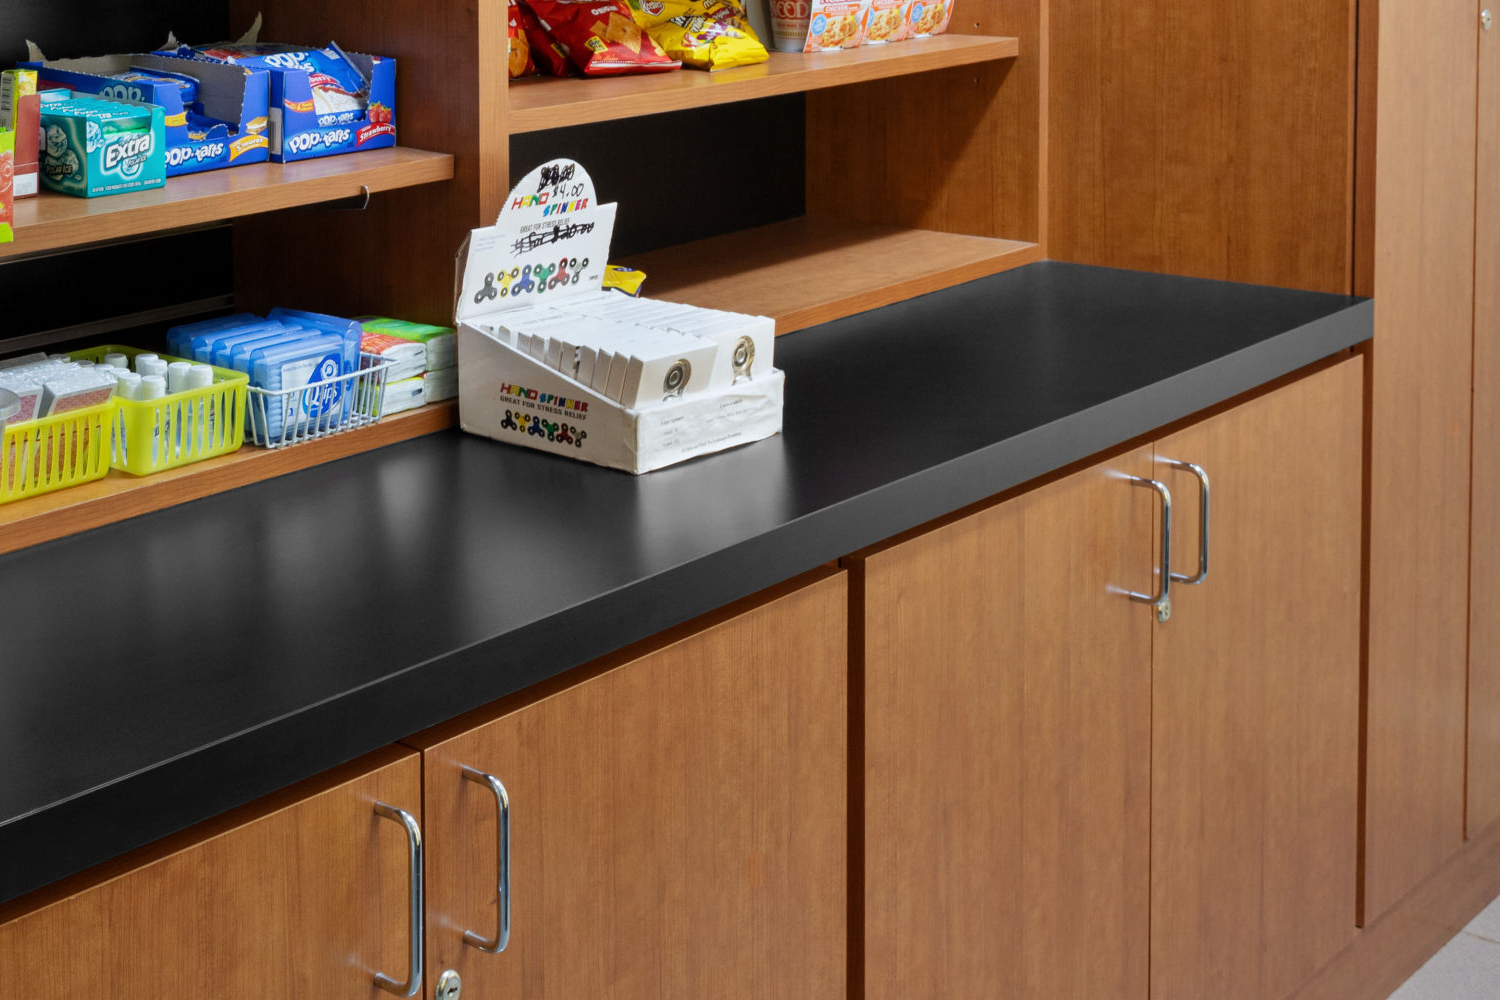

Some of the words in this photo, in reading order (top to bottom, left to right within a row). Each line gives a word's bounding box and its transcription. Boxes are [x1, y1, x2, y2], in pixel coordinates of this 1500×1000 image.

[360, 125, 392, 142] Strawberry
[105, 133, 151, 168] Extra
[552, 183, 584, 199] $4.00
[511, 192, 550, 210] HAND
[543, 198, 589, 217] SPINNER
[500, 382, 537, 400] HAND
[500, 395, 520, 405] GREAT
[522, 400, 535, 409] FOR
[537, 403, 562, 416] STRESS
[564, 410, 587, 421] RELIEF
[539, 392, 589, 413] SPINNER
